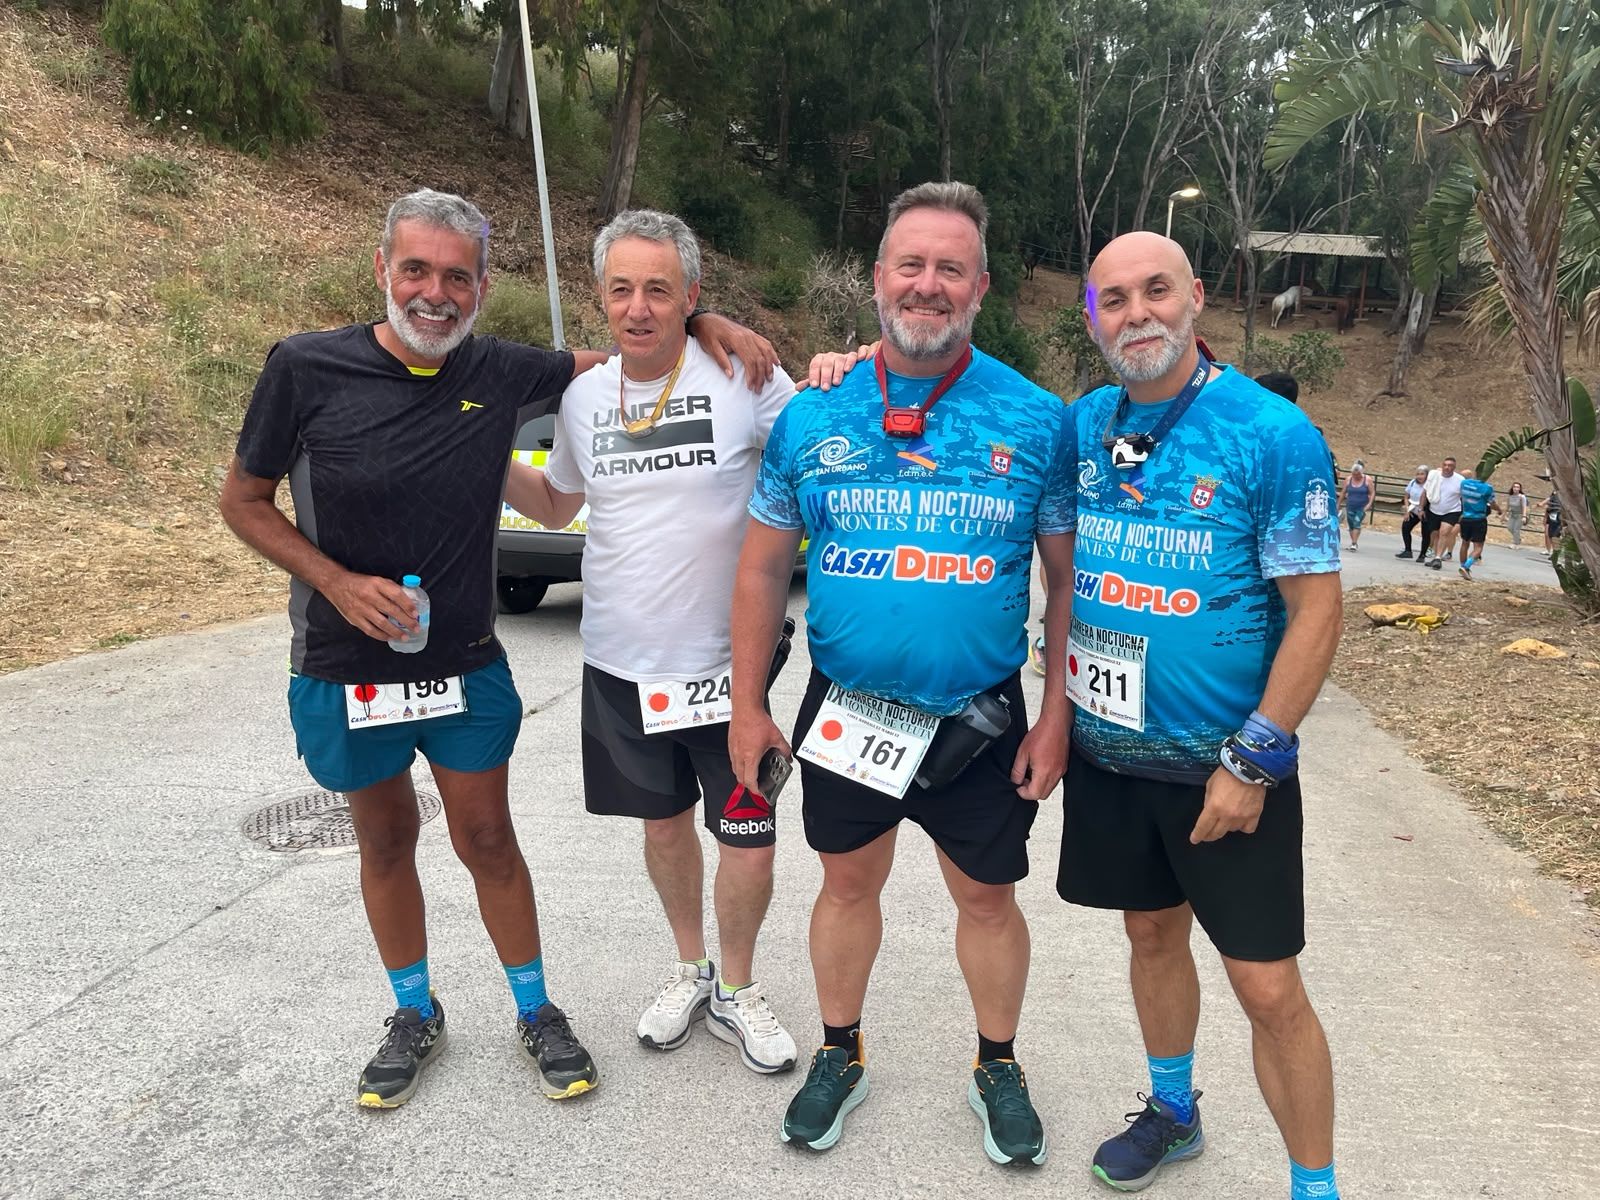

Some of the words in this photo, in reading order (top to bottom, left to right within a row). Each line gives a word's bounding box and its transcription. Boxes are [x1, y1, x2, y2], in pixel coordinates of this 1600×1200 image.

[592, 449, 717, 478] ARMOUR
[815, 467, 830, 475] SAN
[831, 463, 868, 473] URBANO
[828, 488, 912, 515] CARRERA
[919, 490, 1015, 523] NOCTURNA
[832, 513, 909, 533] MONTES
[916, 516, 943, 533] DE
[1077, 513, 1123, 545] ARRERA
[1124, 522, 1213, 555] NOCTURNA
[821, 543, 891, 579] CASH
[893, 545, 996, 584] DIPLO
[1121, 546, 1142, 565] DE
[1147, 551, 1211, 571] CEUTA
[1074, 569, 1101, 600] SH
[1099, 571, 1201, 617] DIPLO
[1096, 627, 1145, 652] NOCTURNA
[1096, 641, 1108, 653] DE
[402, 678, 449, 701] 198
[685, 675, 732, 706] 224
[1088, 663, 1127, 702] 211
[826, 685, 846, 706] IX
[885, 703, 938, 732] NOCTURNA
[883, 717, 898, 729] DE
[900, 722, 932, 741] CEUTA
[859, 734, 908, 772] 161
[719, 818, 775, 835] Reebok
